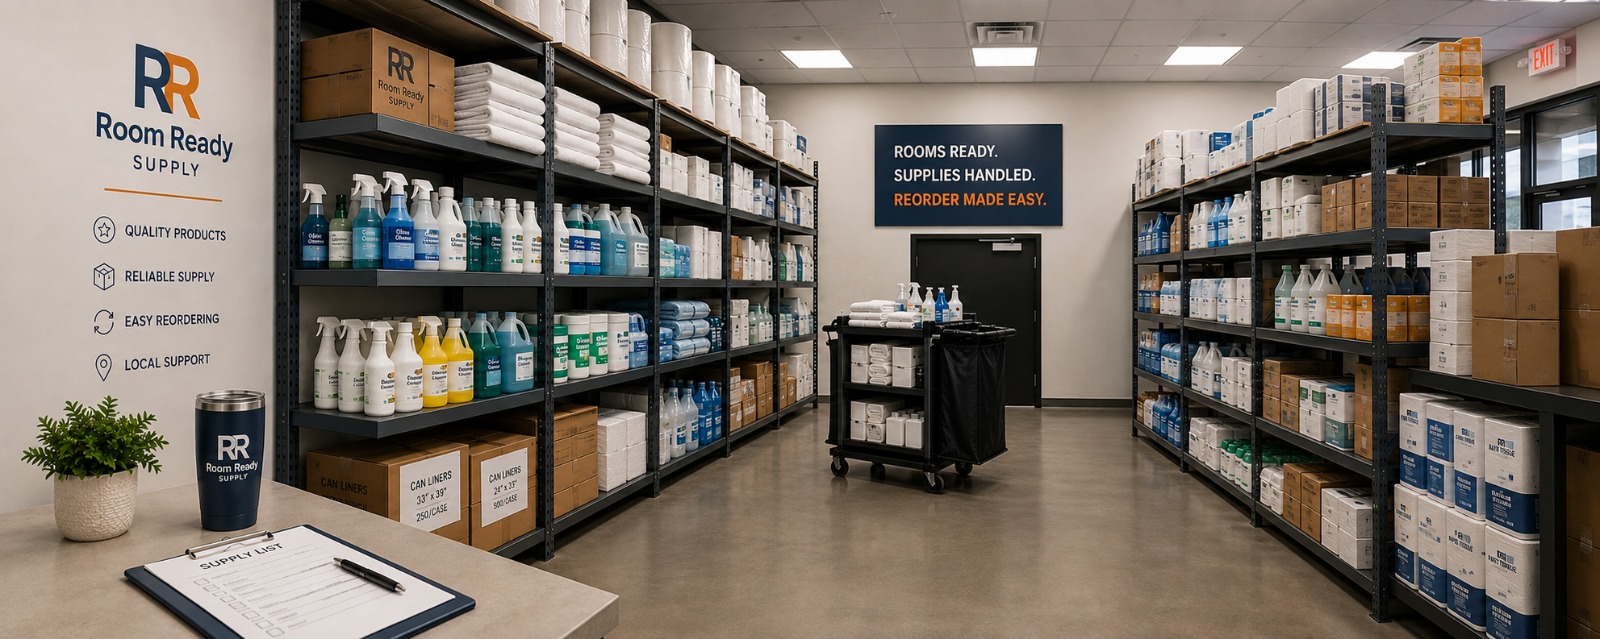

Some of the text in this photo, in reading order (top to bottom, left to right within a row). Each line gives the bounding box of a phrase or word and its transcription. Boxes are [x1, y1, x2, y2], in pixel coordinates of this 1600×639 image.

[388, 46, 414, 84] RR
[1533, 43, 1555, 71] EXIT
[135, 43, 200, 120] RR
[378, 79, 424, 103] Room Ready
[388, 96, 414, 110] SUPPLY
[96, 111, 233, 162] Room Ready
[894, 145, 998, 158] ROOMS READY.
[133, 155, 199, 177] SUPPLY
[894, 168, 1036, 182] SUPPLIES HANDLED.
[894, 193, 1047, 206] REORDER MADE EASY.
[125, 224, 226, 241] QUALITY PRODUCTS
[125, 270, 215, 283] RELIABLE SUPPLY
[125, 313, 219, 328] EASY REORDERING
[125, 354, 210, 371] LOCAL SUPPORT
[217, 434, 250, 461] RR
[206, 460, 258, 473] Room Ready
[488, 465, 522, 484] CAN LINERS
[218, 473, 248, 482] SUPPLY
[321, 476, 368, 496] CAN LINERS
[410, 470, 453, 492] CAN LINERS
[416, 503, 448, 523] 250/CASE
[199, 542, 284, 570] SUPPLY LIST
